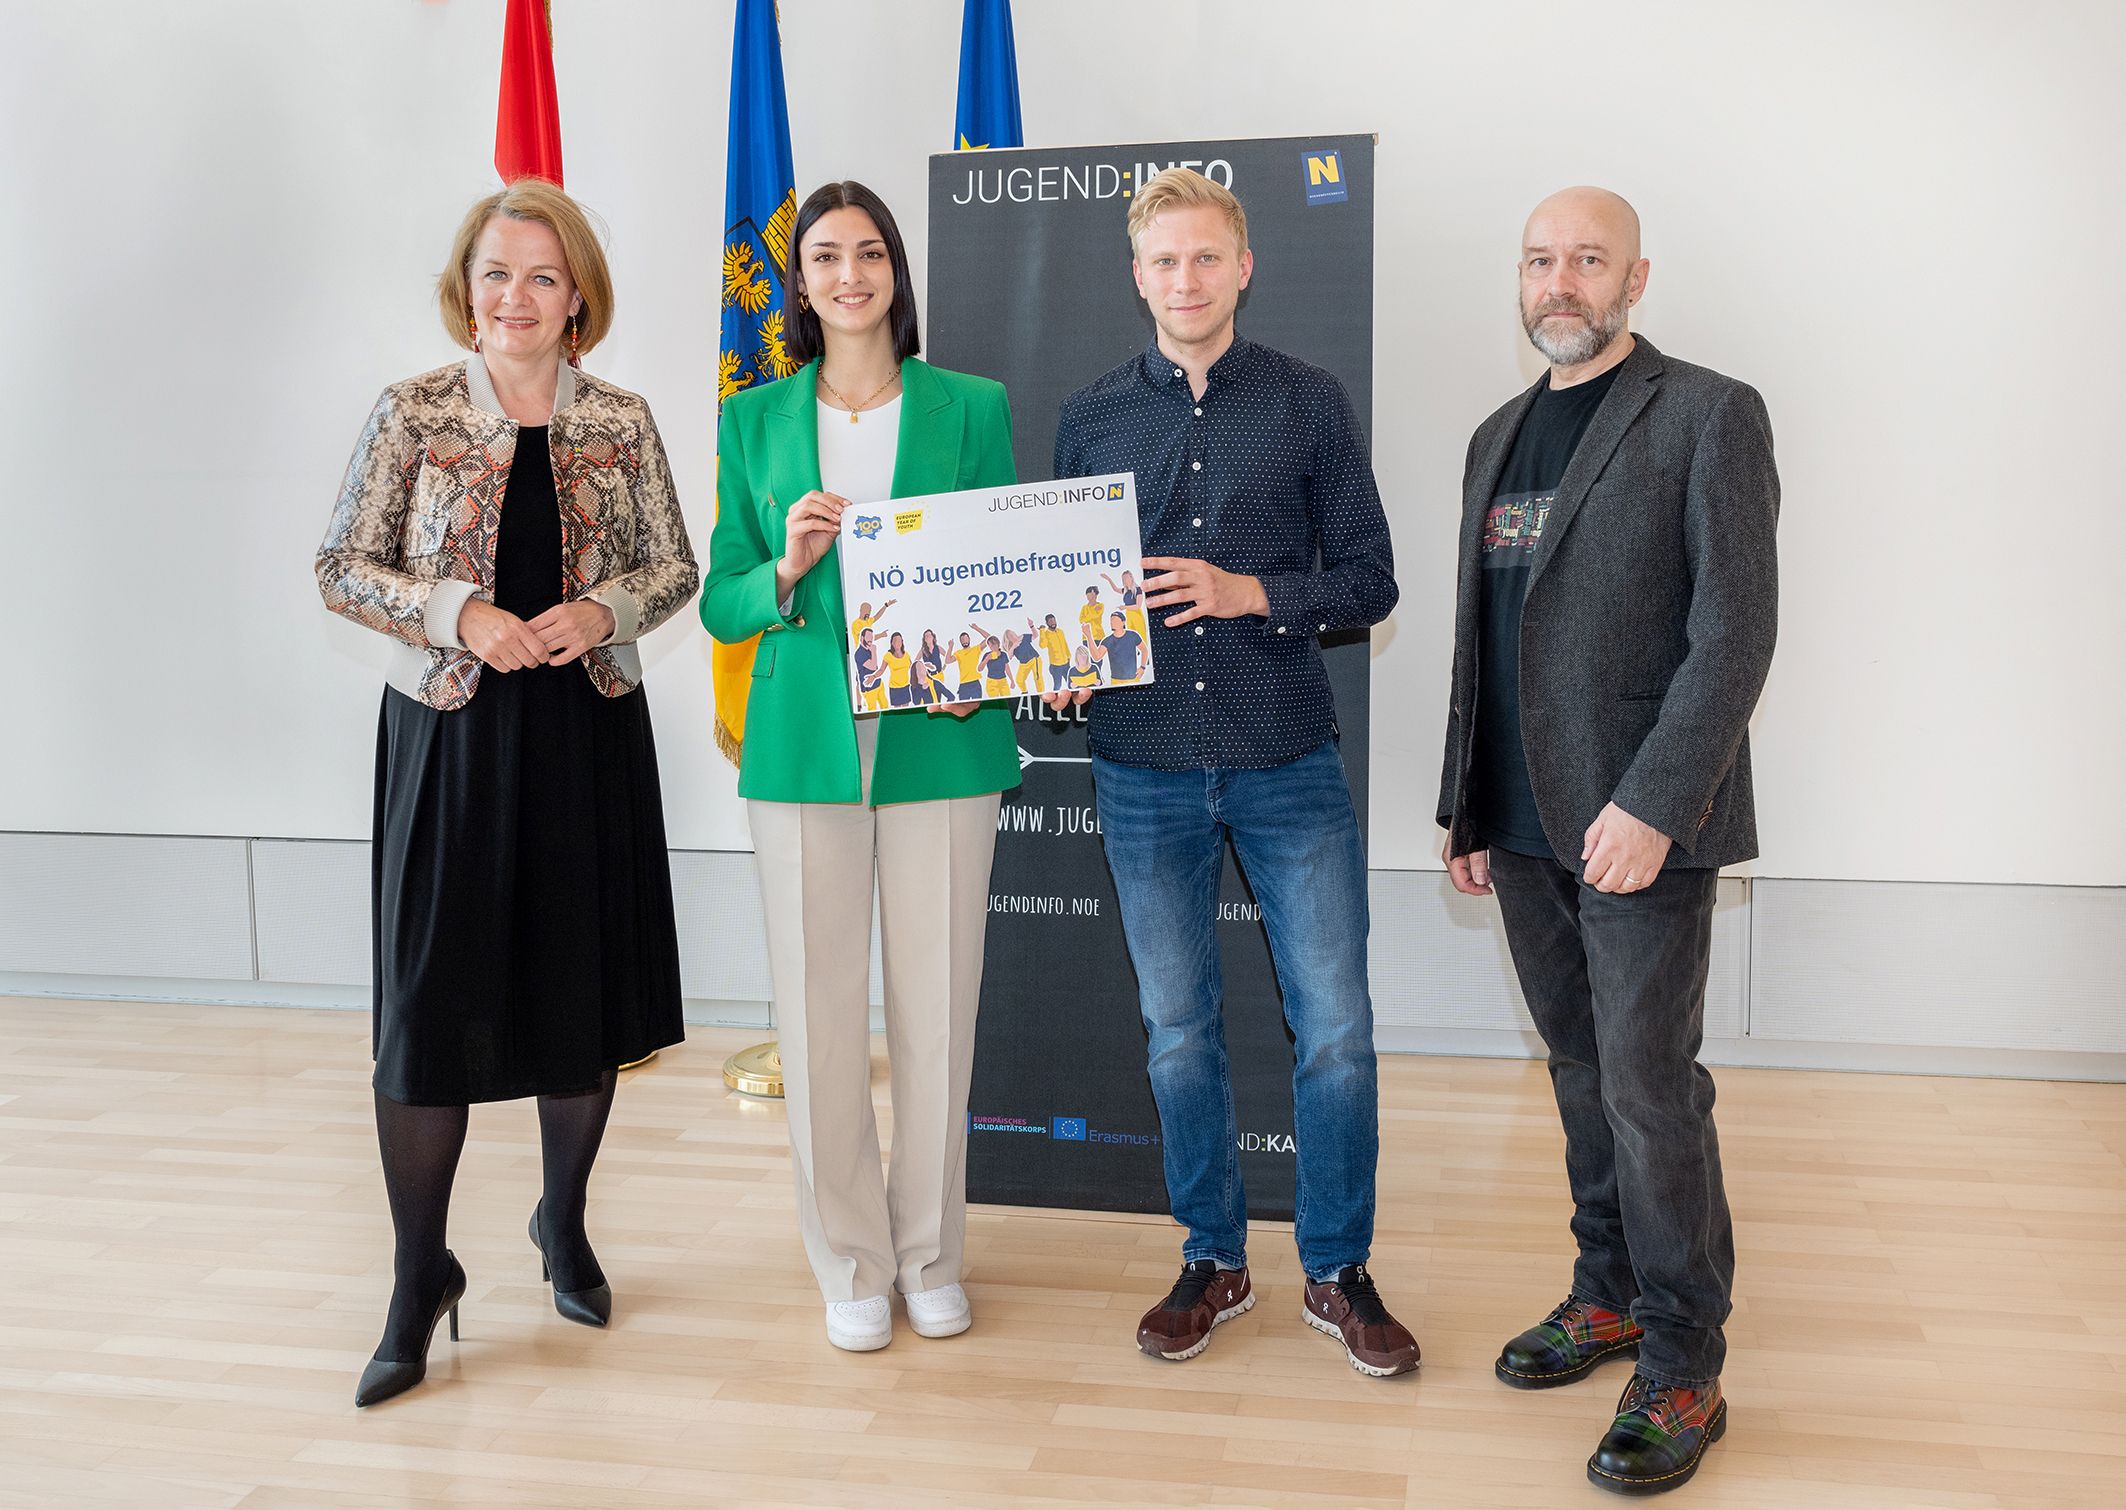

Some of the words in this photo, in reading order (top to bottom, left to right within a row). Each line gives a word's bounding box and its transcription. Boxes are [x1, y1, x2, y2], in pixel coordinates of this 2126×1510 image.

[988, 486, 1105, 513] JUGEND:INFO
[868, 564, 905, 590] NÖ
[912, 547, 1122, 586] Jugendbefragung
[967, 589, 1023, 613] 2022
[973, 1115, 1027, 1126] EUROPÄISCHES
[973, 1123, 1047, 1134] SOLIDARITÄTSKORPS
[1089, 1129, 1160, 1145] Erasmus+
